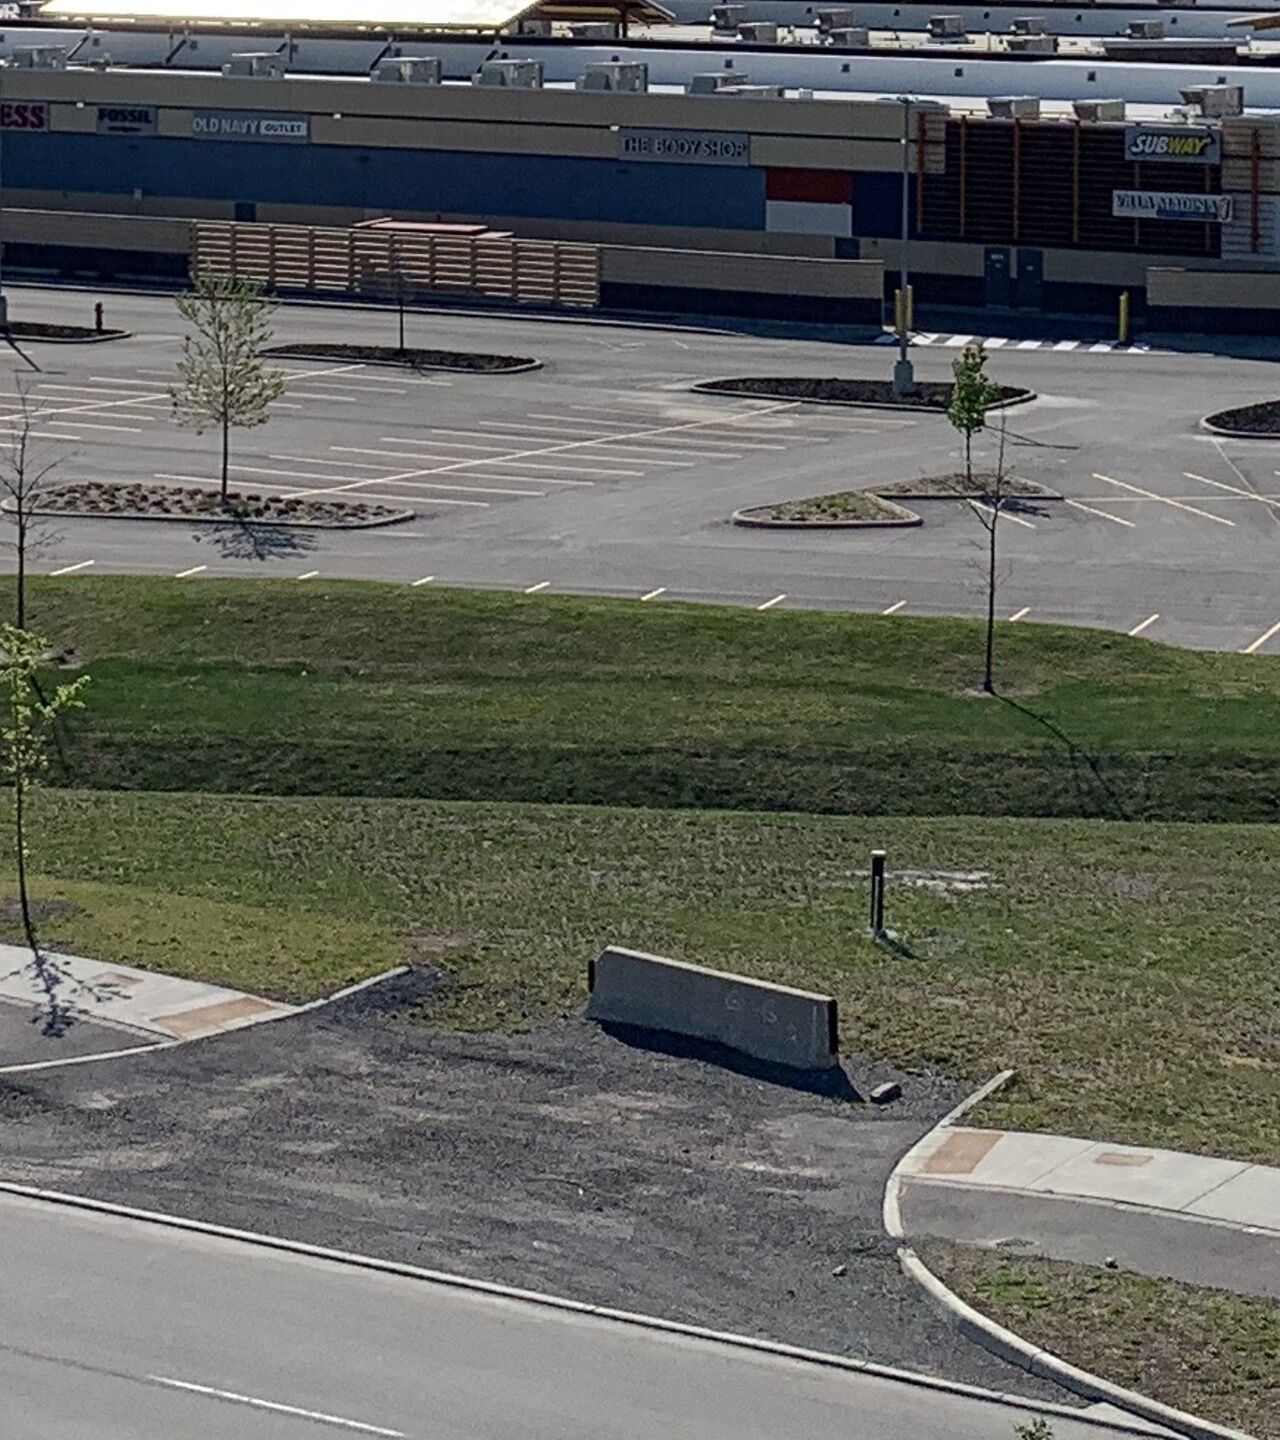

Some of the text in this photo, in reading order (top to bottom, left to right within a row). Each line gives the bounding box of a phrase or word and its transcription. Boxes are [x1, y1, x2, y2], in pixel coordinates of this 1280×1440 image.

[97, 108, 152, 123] FOSSIL
[192, 118, 301, 134] OLD NAVY OUTLET
[623, 138, 746, 157] THE BODY SHOP
[1131, 135, 1212, 154] SUBWAY
